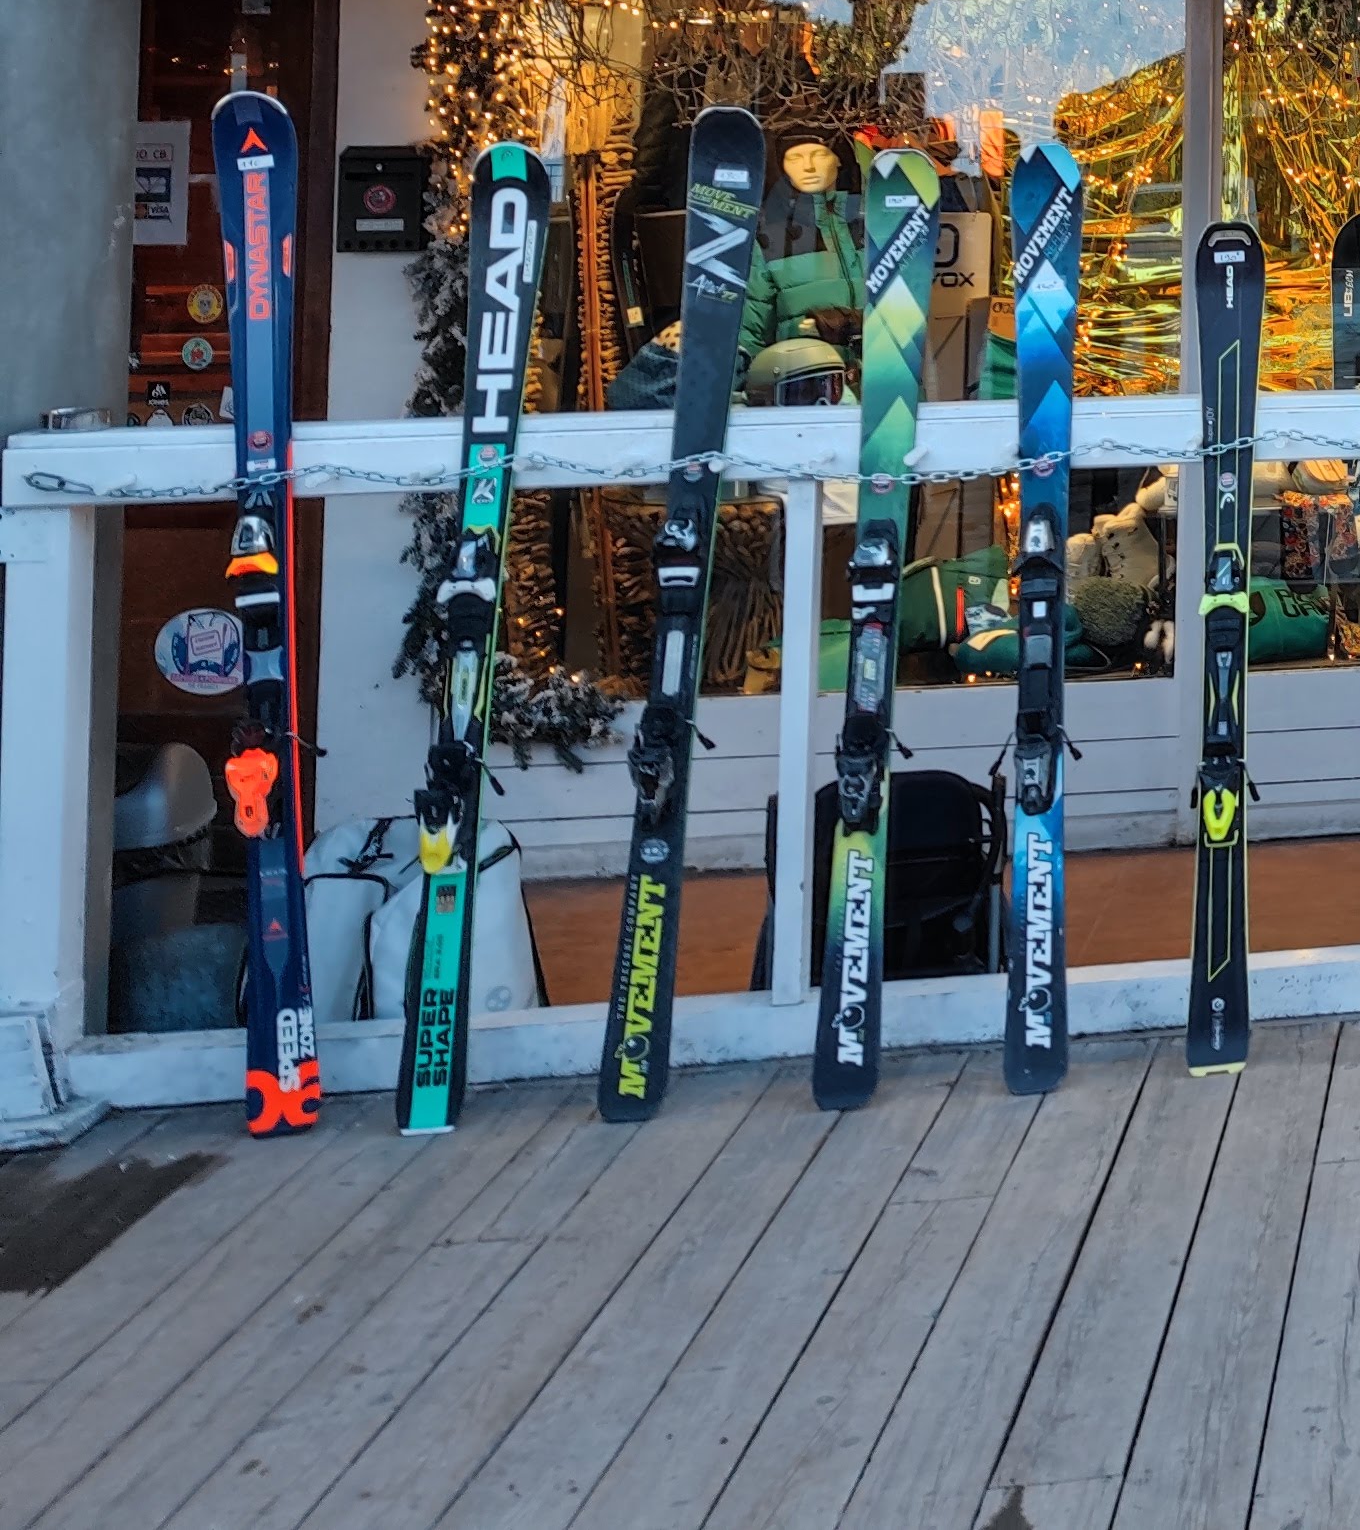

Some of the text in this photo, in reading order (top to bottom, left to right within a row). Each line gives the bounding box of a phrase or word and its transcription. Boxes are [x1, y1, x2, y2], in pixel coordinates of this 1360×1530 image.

[246, 171, 272, 321] DYNASTAR
[864, 202, 931, 295] MOVEMENT
[1012, 185, 1074, 284] MOVEMENT
[471, 186, 530, 434] HEAD
[1225, 265, 1234, 308] HEAD
[617, 873, 667, 1100] MOVEMENT
[835, 848, 876, 1067] MOVEMENT
[1023, 831, 1054, 1050] MOVEMENT
[276, 1007, 301, 1093] SPEED
[297, 1006, 316, 1059] ZONE
[416, 987, 438, 1088] SUPER
[433, 987, 456, 1088] SHAPE
